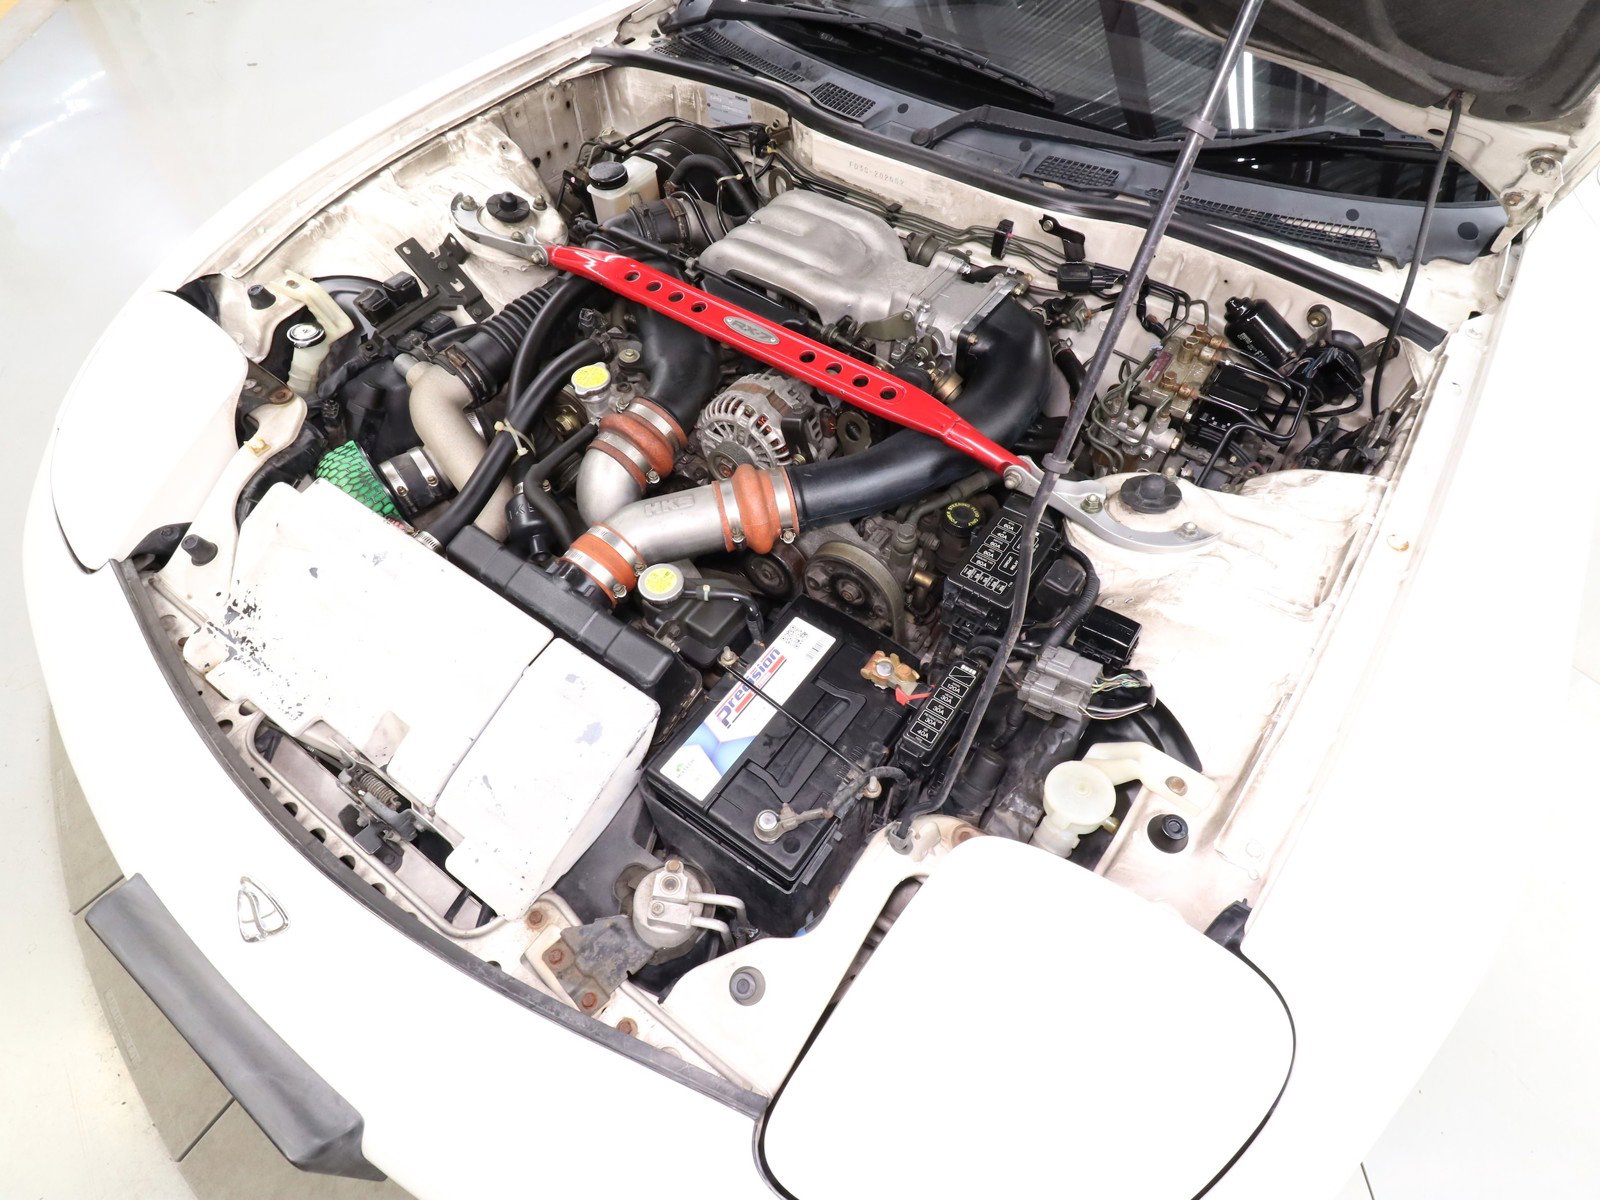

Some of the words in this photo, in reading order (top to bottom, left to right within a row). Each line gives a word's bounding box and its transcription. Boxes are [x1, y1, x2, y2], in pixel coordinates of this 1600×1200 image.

[644, 494, 695, 517] HKS
[947, 683, 961, 694] 120A
[940, 694, 952, 704] 30A
[932, 705, 944, 716] 30A
[924, 717, 937, 727] 30A
[916, 729, 929, 739] 40A
